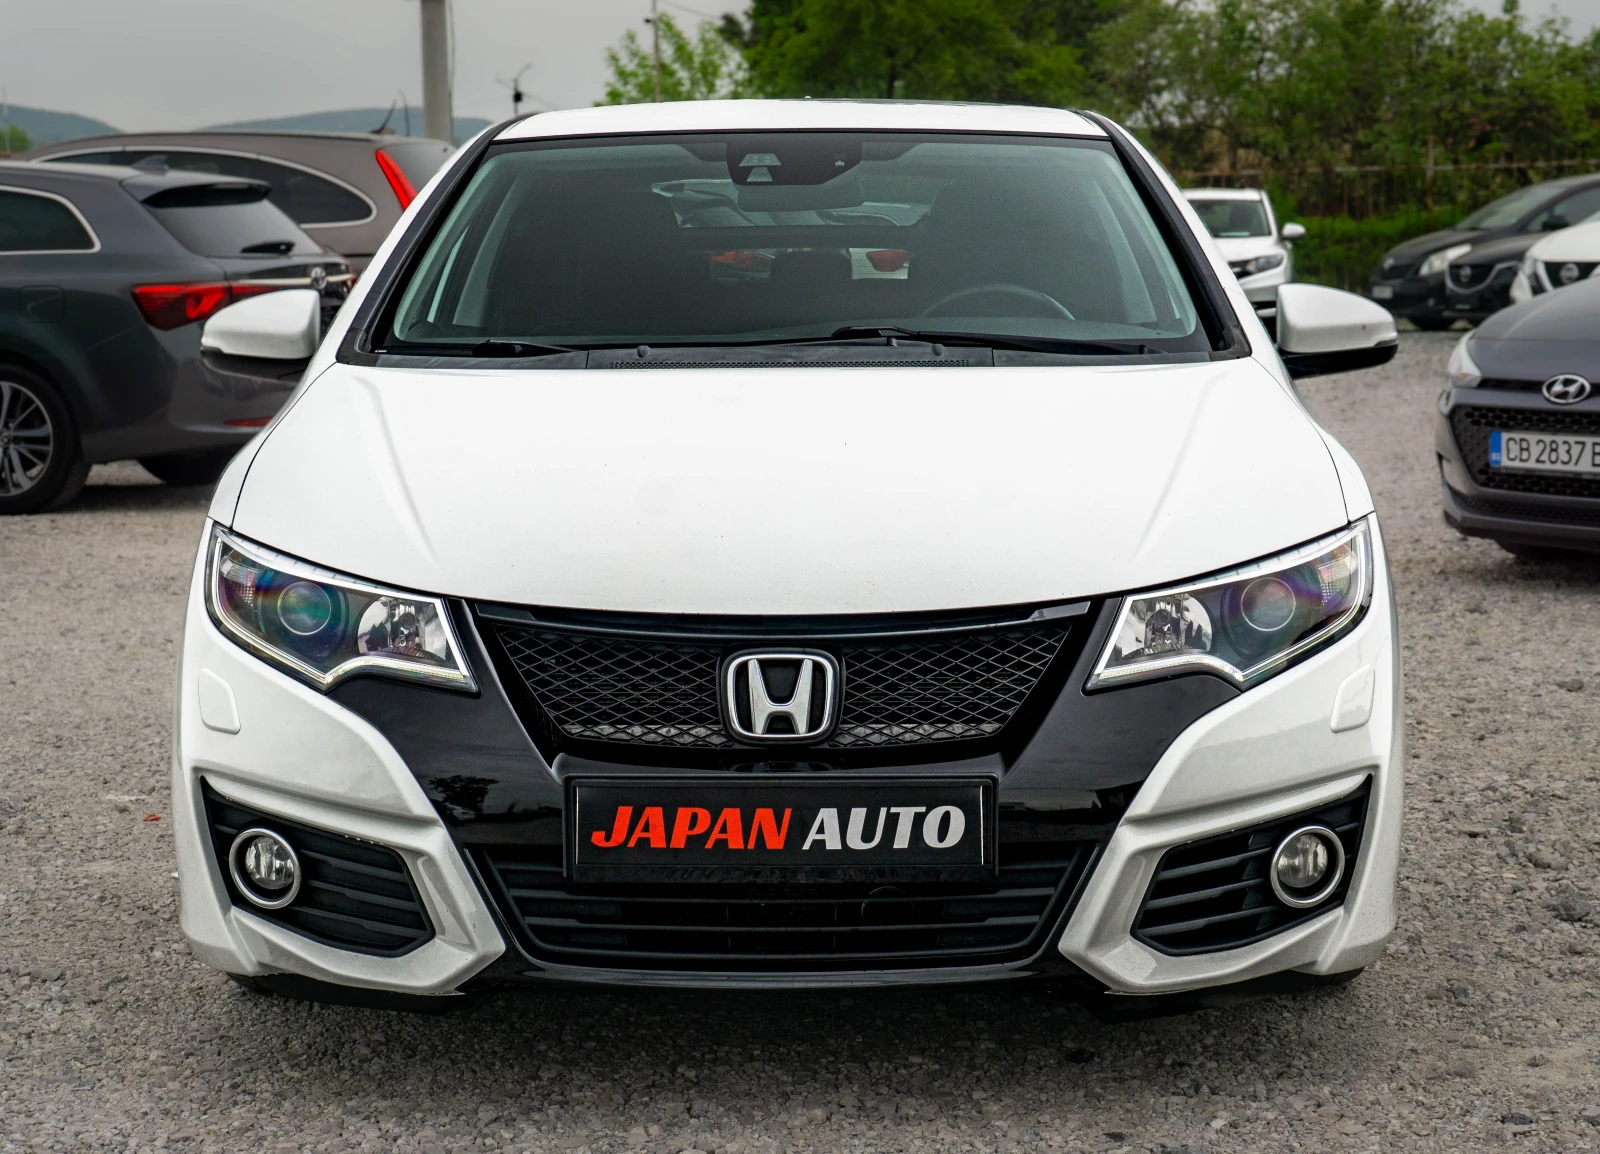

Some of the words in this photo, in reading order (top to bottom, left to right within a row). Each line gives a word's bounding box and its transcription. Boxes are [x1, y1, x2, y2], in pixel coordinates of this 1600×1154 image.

[1535, 439, 1586, 466] 2837
[591, 806, 792, 850] JAPAN
[802, 805, 966, 850] AUTO
